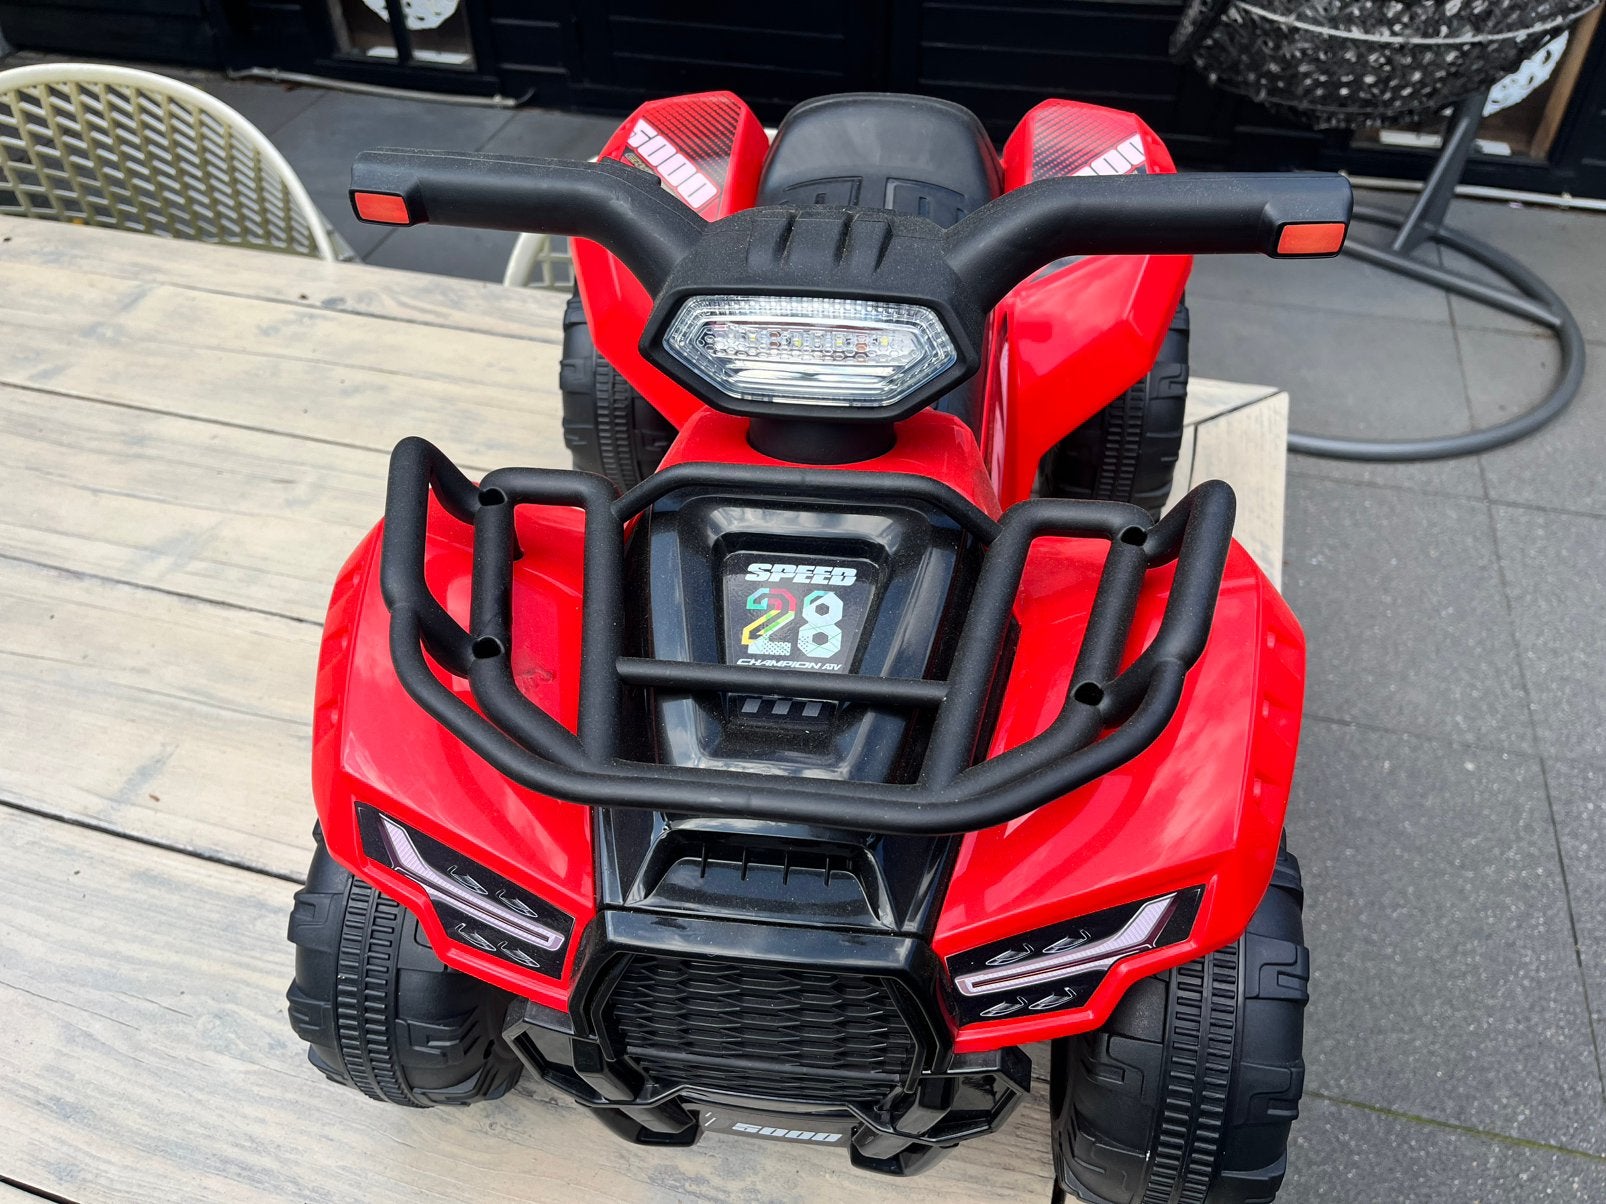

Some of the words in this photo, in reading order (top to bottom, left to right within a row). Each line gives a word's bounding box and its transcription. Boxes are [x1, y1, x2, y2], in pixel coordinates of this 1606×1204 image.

[745, 563, 857, 586] SPEED
[741, 588, 843, 658] 28
[736, 658, 822, 670] CHAMPION
[822, 663, 843, 671] ATV
